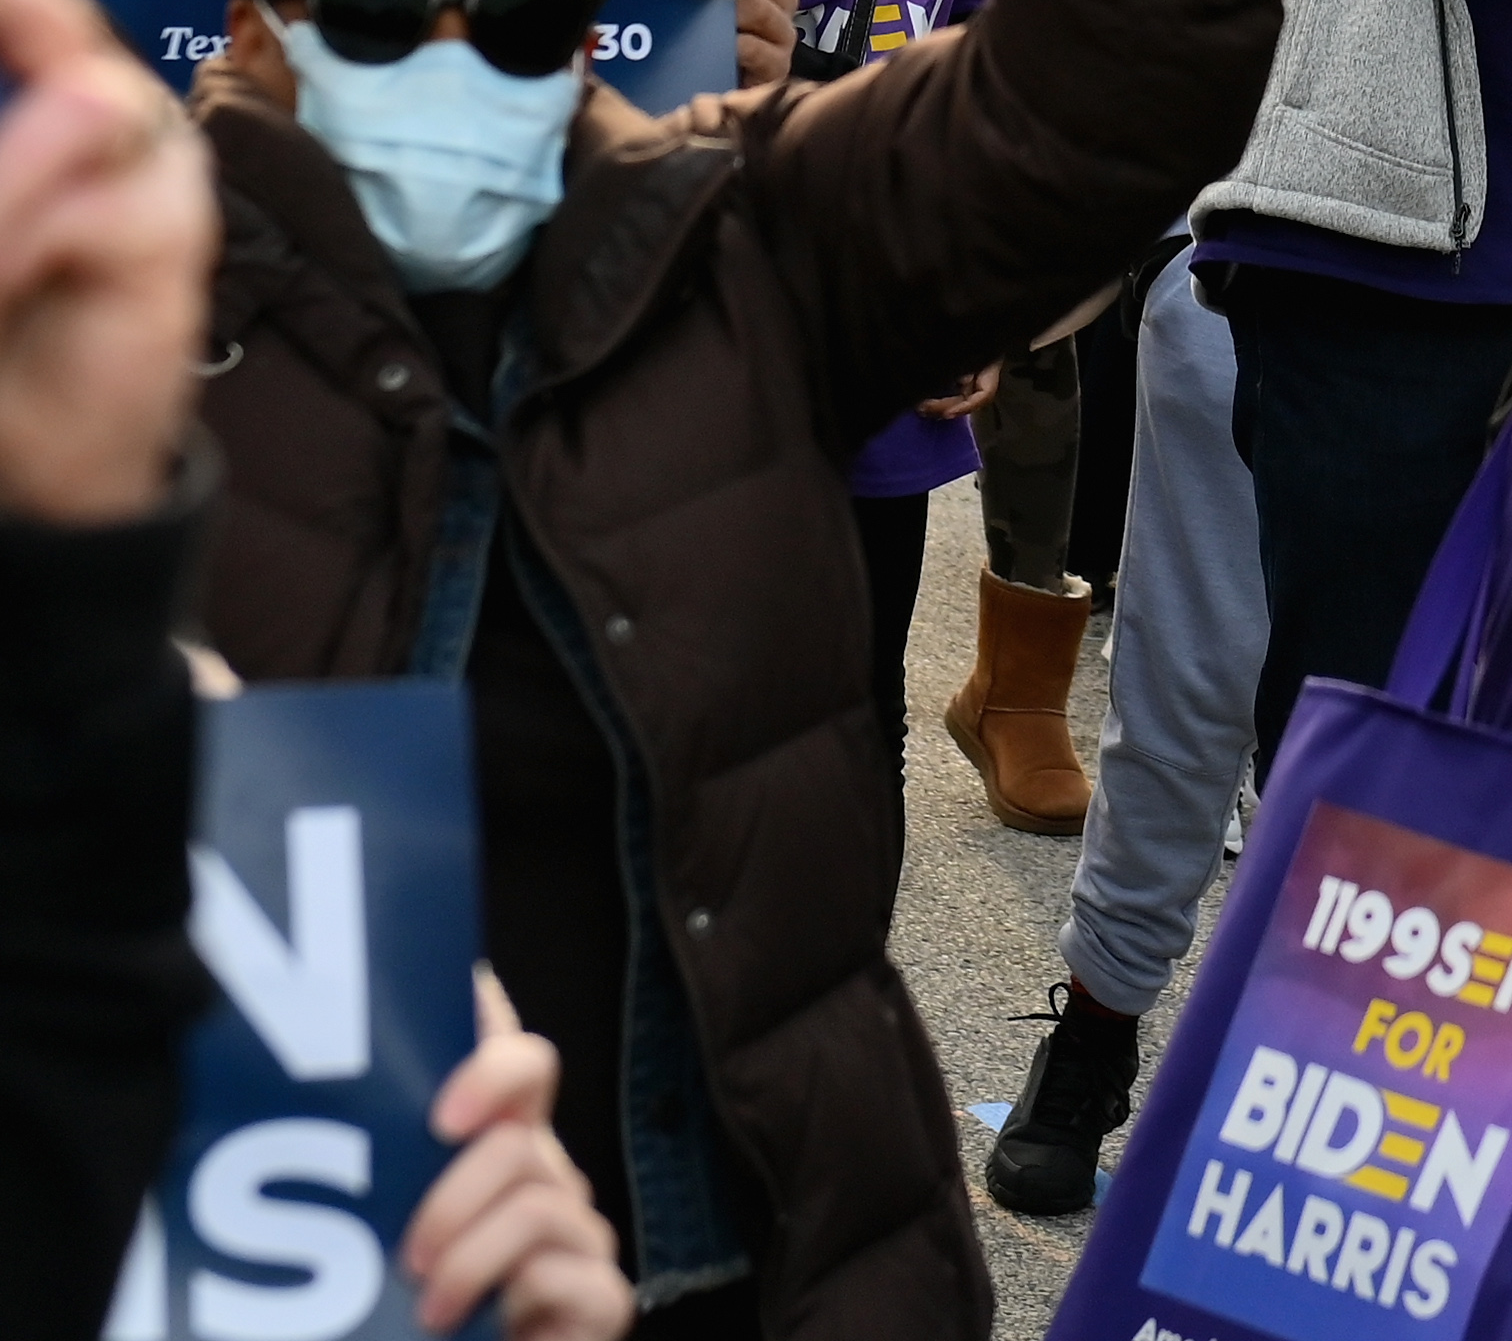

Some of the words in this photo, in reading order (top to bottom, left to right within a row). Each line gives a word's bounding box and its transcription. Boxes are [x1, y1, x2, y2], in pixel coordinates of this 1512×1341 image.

[159, 25, 234, 61] Tex
[1351, 997, 1466, 1084] FOR
[1218, 1043, 1511, 1229] BIDEN
[1187, 1158, 1459, 1321] HARRIS
